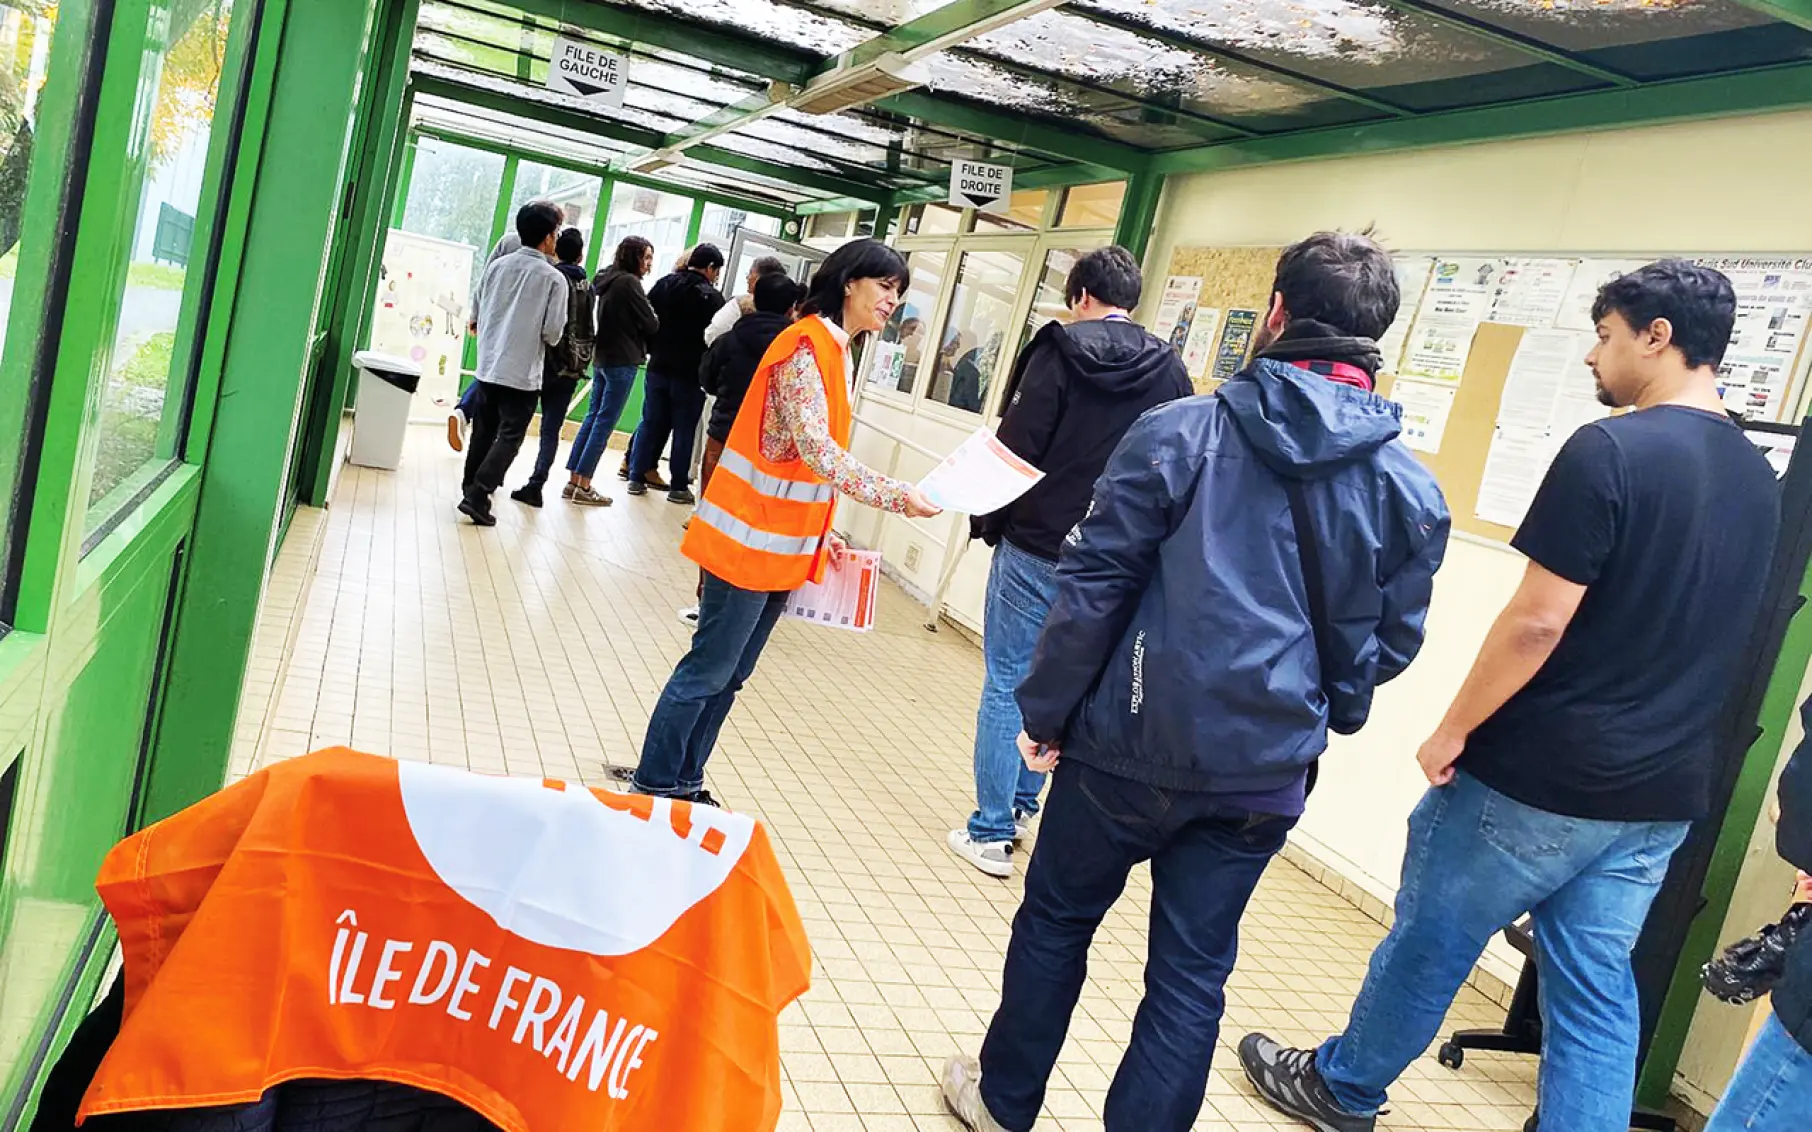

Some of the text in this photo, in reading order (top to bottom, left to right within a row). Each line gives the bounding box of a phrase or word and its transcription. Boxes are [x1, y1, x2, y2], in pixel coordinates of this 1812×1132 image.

[565, 45, 618, 71] FILE DE
[560, 58, 619, 85] GAUCHE
[961, 163, 1003, 179] FILE DE
[960, 179, 1002, 194] DROITE
[1794, 258, 1812, 270] Clu
[328, 909, 659, 1100] ÎLE DE FRANCE
